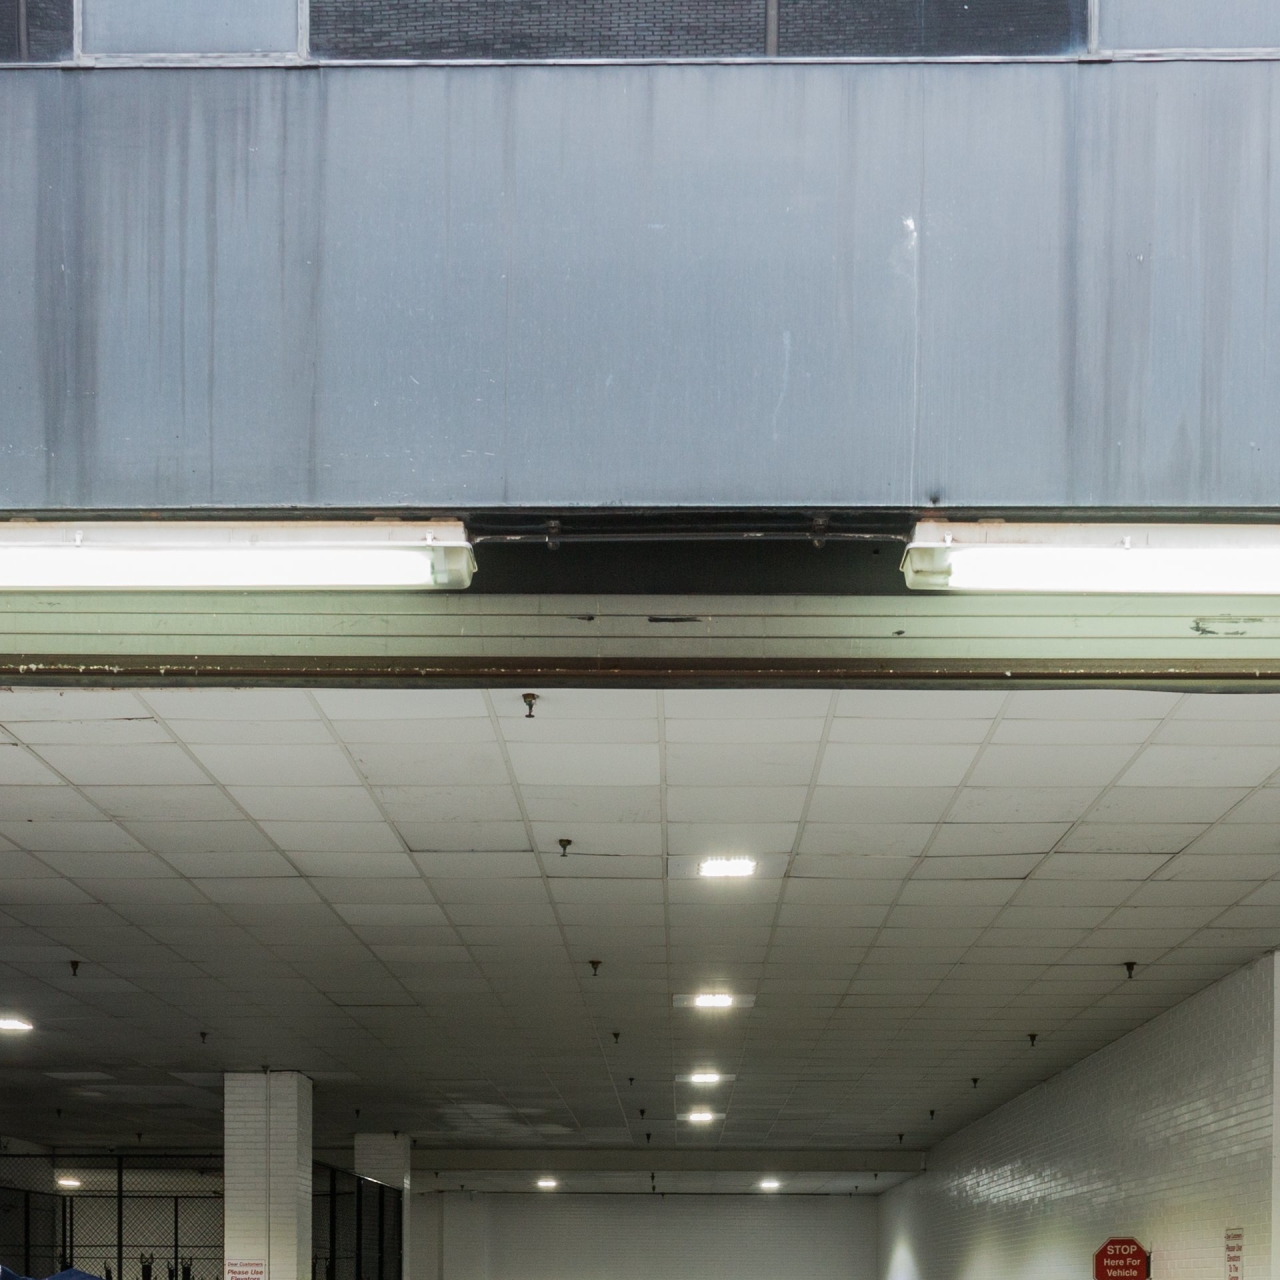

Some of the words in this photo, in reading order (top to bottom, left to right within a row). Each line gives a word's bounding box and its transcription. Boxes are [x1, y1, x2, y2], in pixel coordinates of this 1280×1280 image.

[1107, 1245, 1137, 1255] STOP
[1103, 1258, 1124, 1266] Here
[1126, 1258, 1141, 1266] For
[1106, 1269, 1138, 1277] Vehicle
